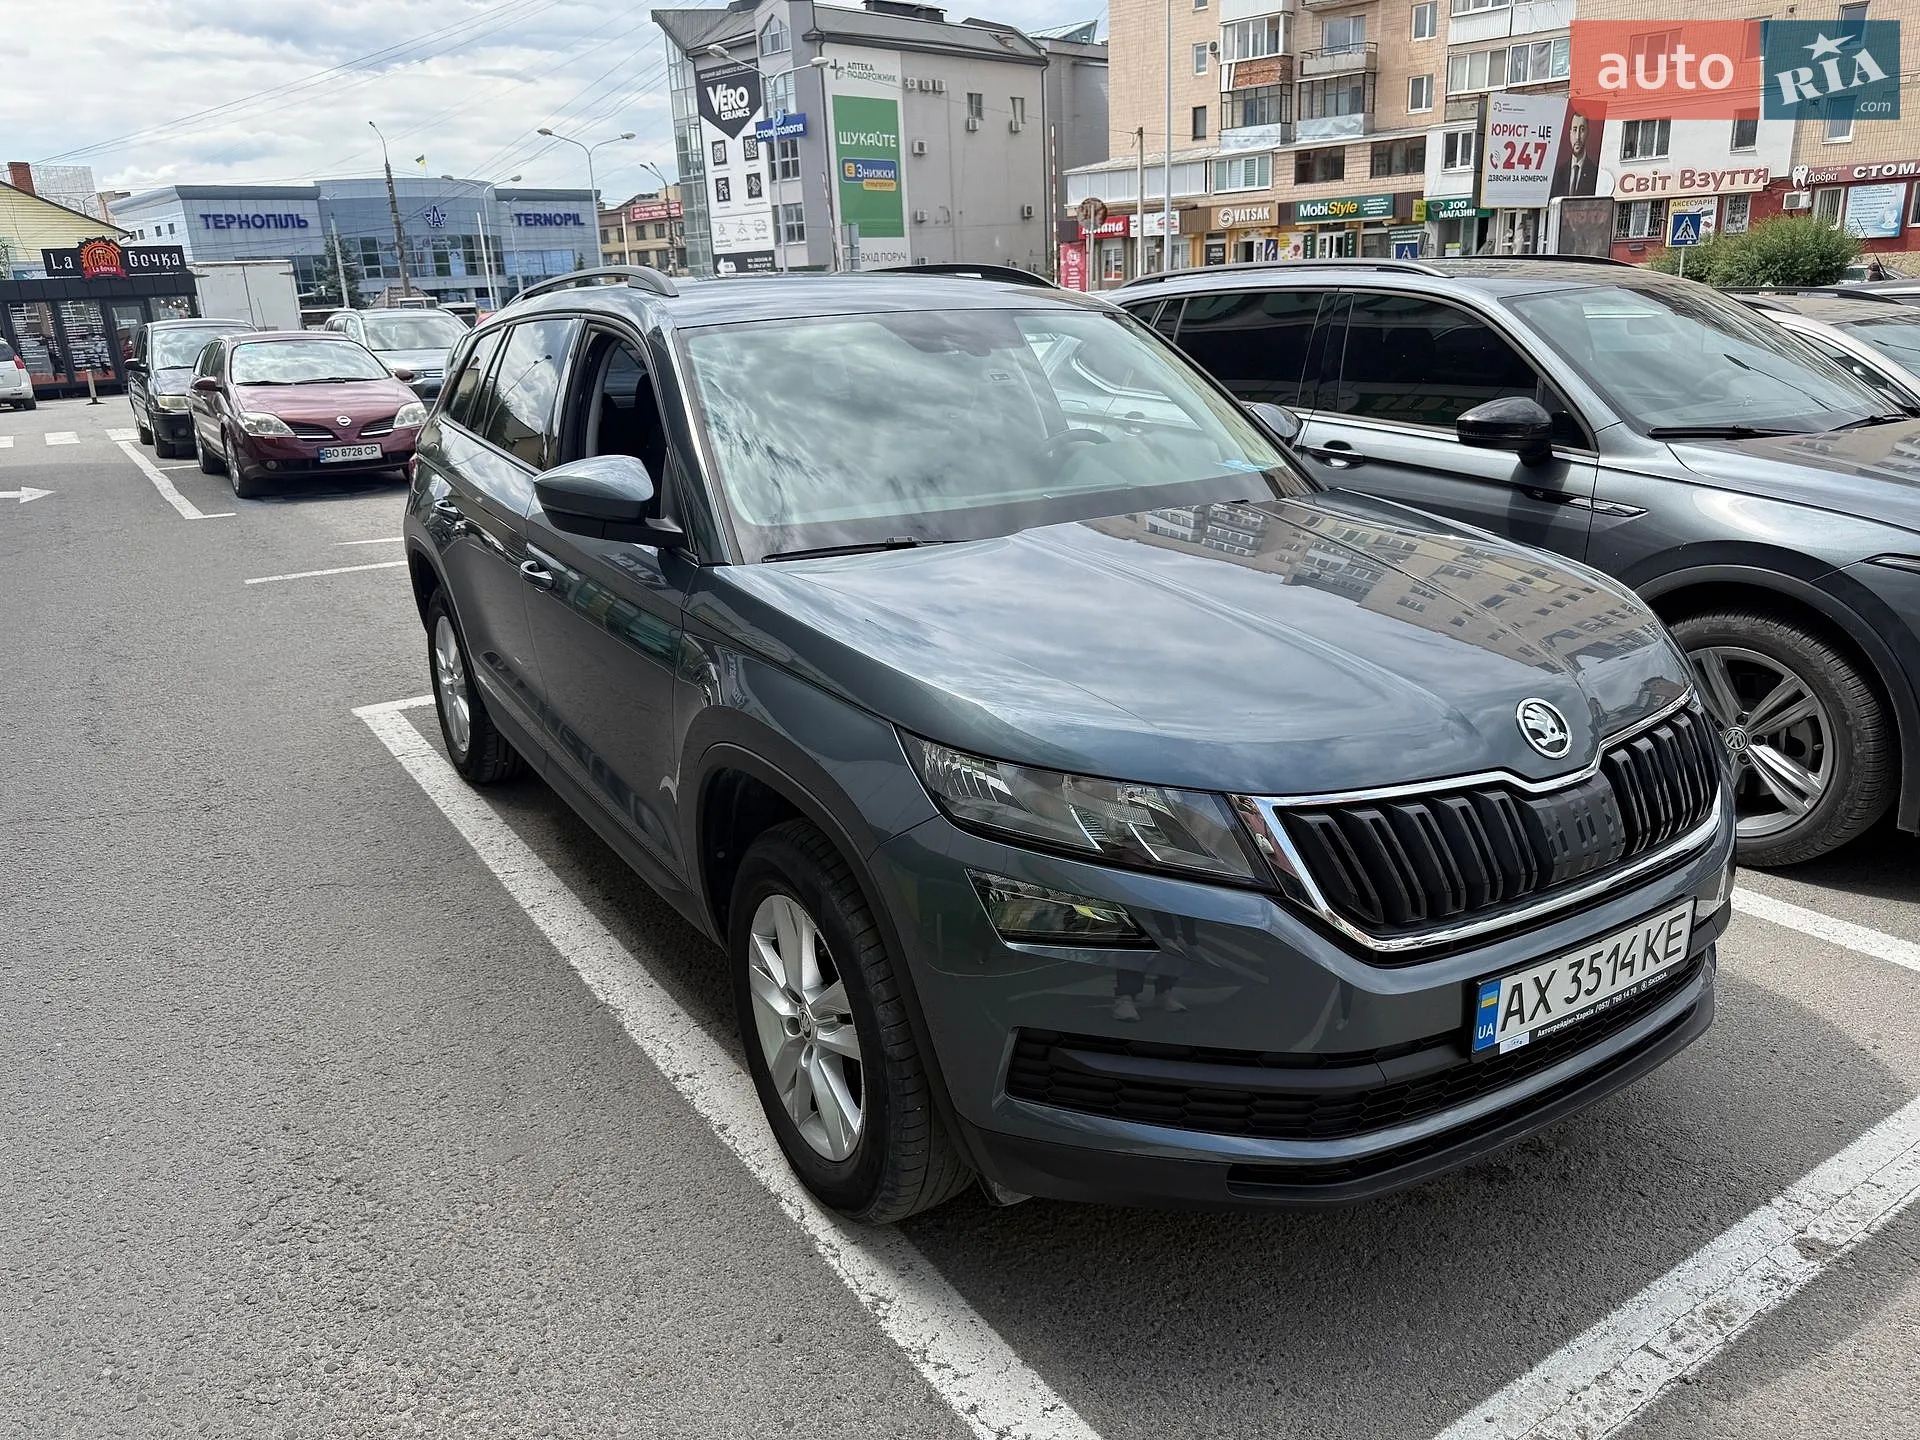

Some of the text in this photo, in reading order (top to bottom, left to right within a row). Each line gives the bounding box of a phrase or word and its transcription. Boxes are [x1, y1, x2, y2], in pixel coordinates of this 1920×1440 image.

[847, 61, 874, 71] АПТЕКА
[847, 70, 897, 82] ПОДОРОЖНИК
[720, 108, 751, 121] CERAMICS
[756, 123, 804, 139] СТОМТОЛОГІЯ
[1491, 123, 1529, 137] ЮРИСТ
[1538, 125, 1552, 140] ЦЕ
[838, 131, 897, 148] ШУКАЙТЕ
[1488, 174, 1511, 183] ДЗВОНИ
[1520, 175, 1548, 183] НОМЕРОМ
[1808, 171, 1838, 184] Добра
[1853, 162, 1920, 179] СТОМ
[1618, 167, 1770, 194] Світ Взуття
[200, 212, 309, 231] ТЕРНОПІЛЬ
[514, 212, 585, 228] TERNOPIL
[1233, 206, 1271, 222] VATSAK
[1439, 208, 1476, 219] МАГАЗИН
[50, 252, 74, 270] La
[325, 446, 378, 458] BO 8728 CP
[1477, 911, 1688, 1040] UA AX 3514 KE
[1623, 989, 1630, 999] 14
